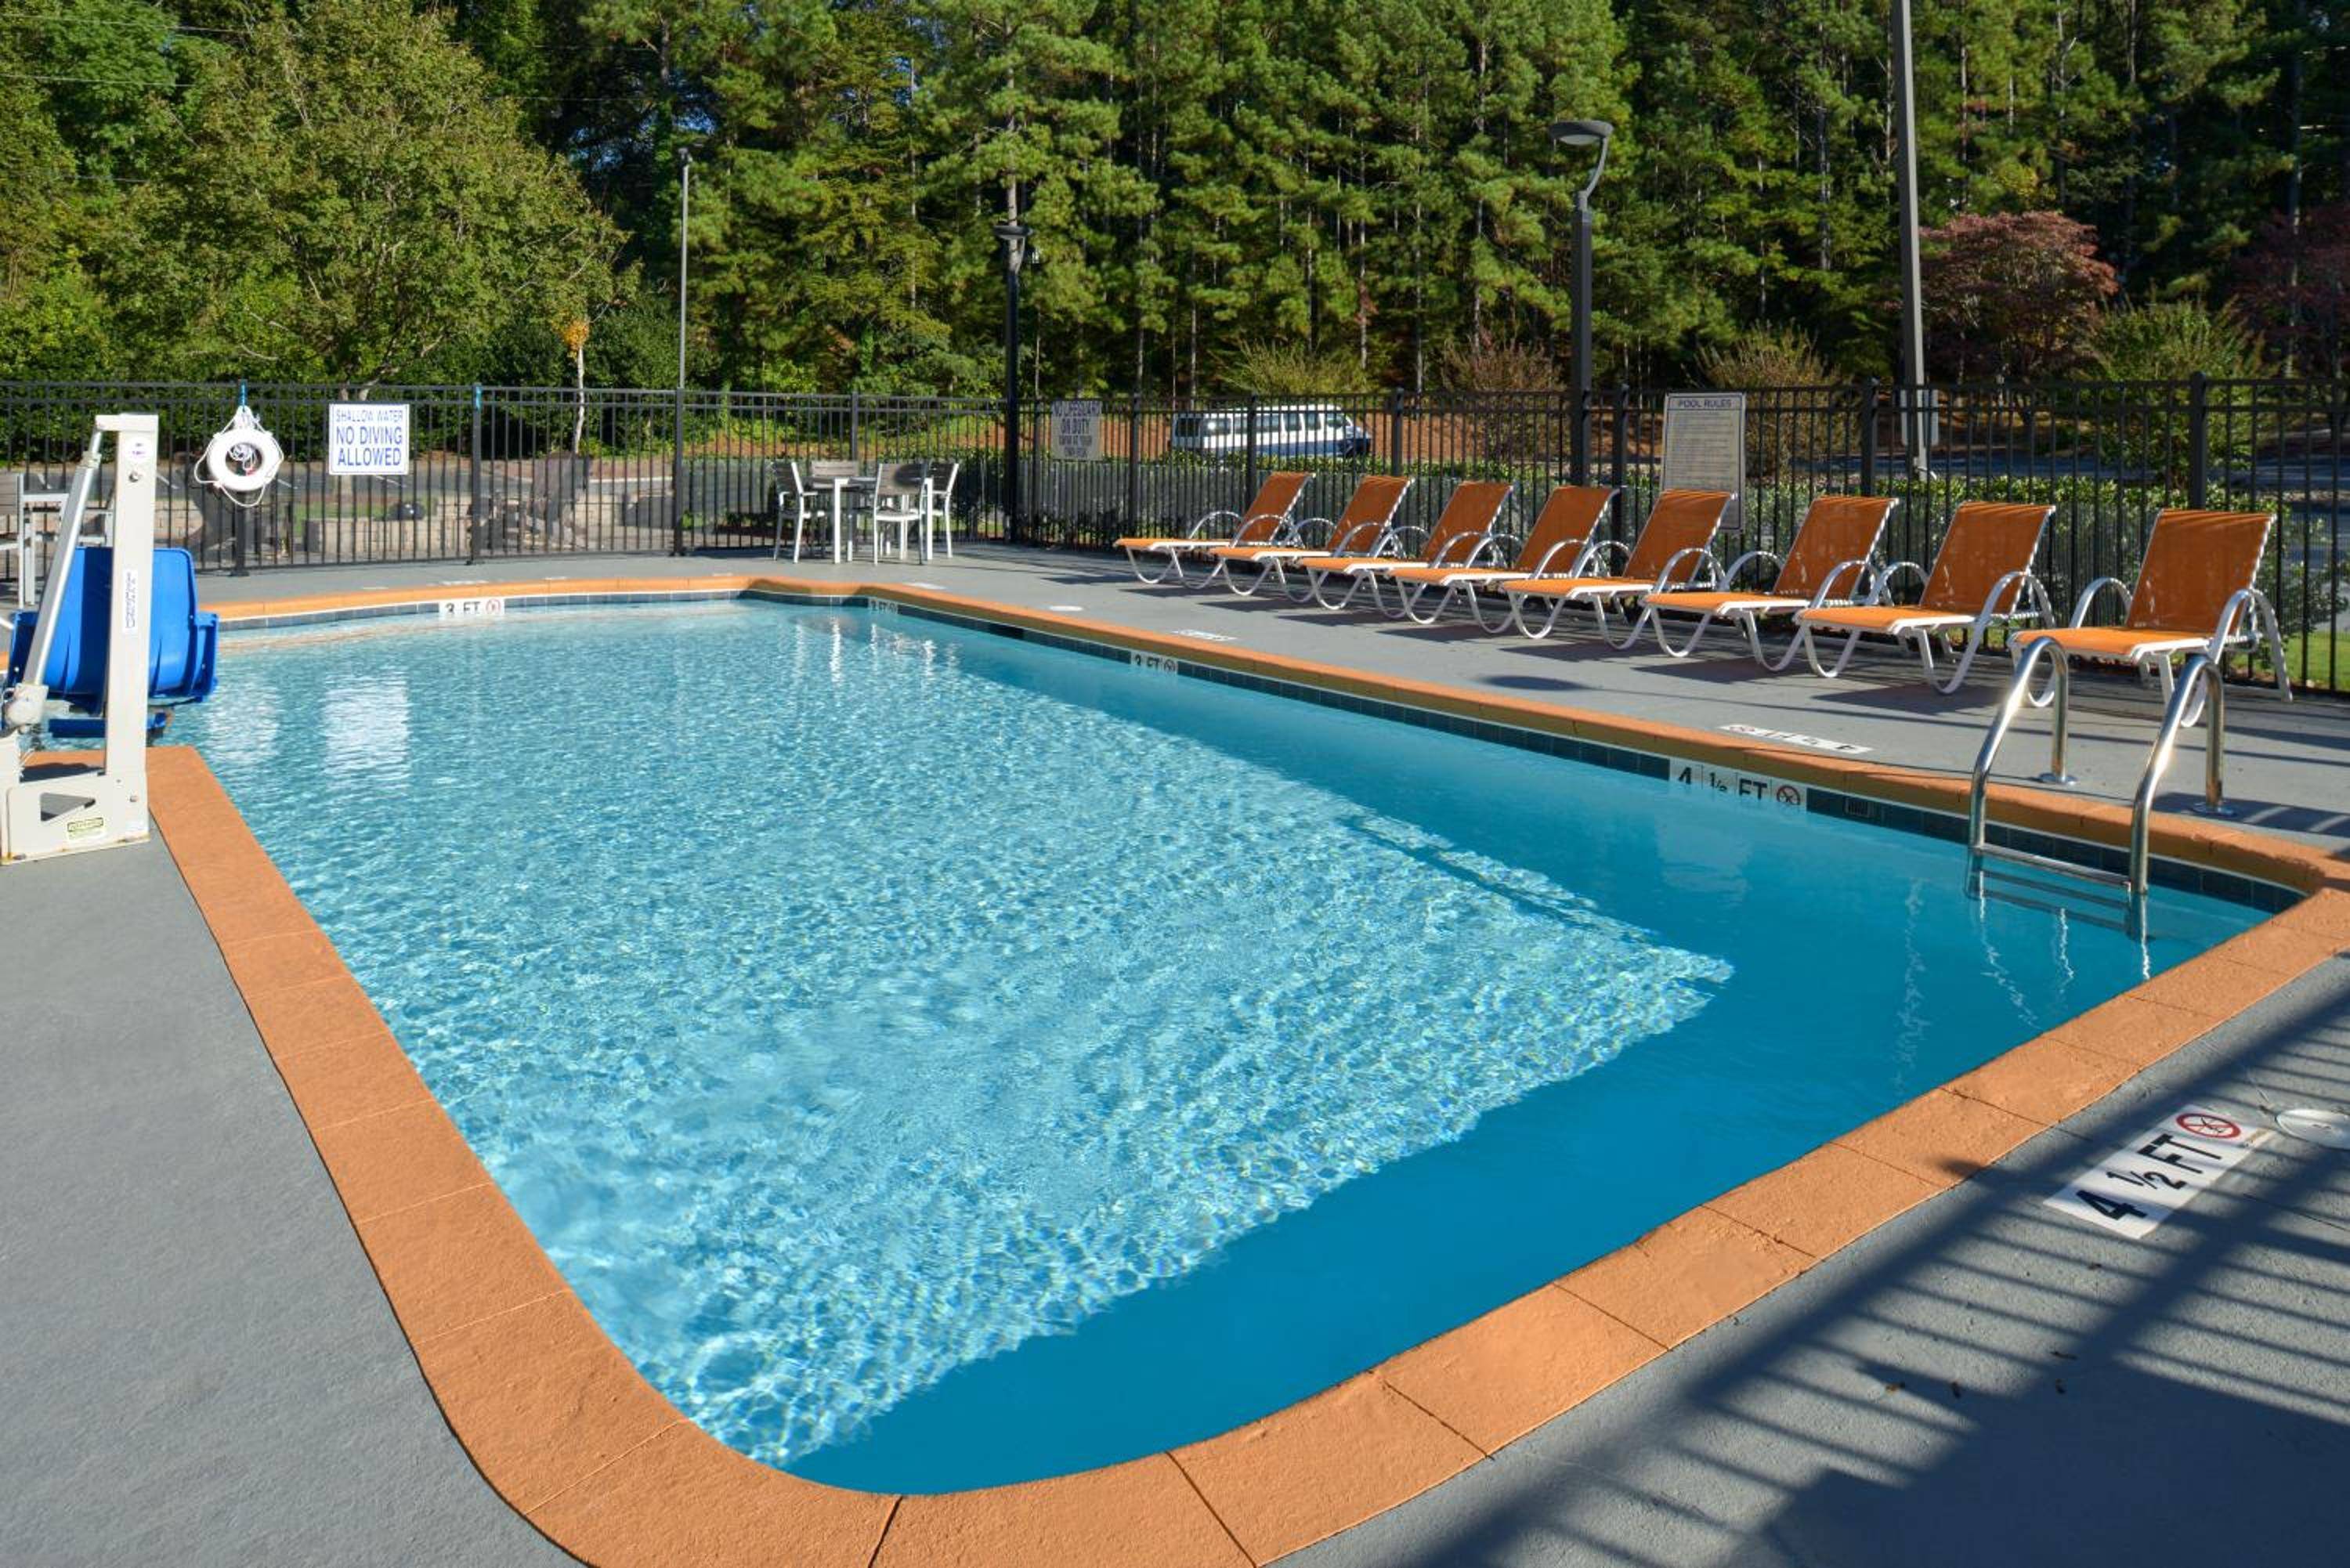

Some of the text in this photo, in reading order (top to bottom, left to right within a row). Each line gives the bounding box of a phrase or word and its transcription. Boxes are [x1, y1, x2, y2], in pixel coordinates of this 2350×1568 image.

[336, 410, 403, 422] SHALLOW WATER
[336, 426, 402, 445] NO DIVING
[338, 447, 401, 466] ALLOWED
[463, 602, 481, 613] FT
[1147, 656, 1160, 669] FT
[1678, 767, 1692, 785] 4
[1738, 778, 1768, 800] FT
[2076, 1189, 2148, 1221] 4
[2137, 1133, 2222, 1175] FT
